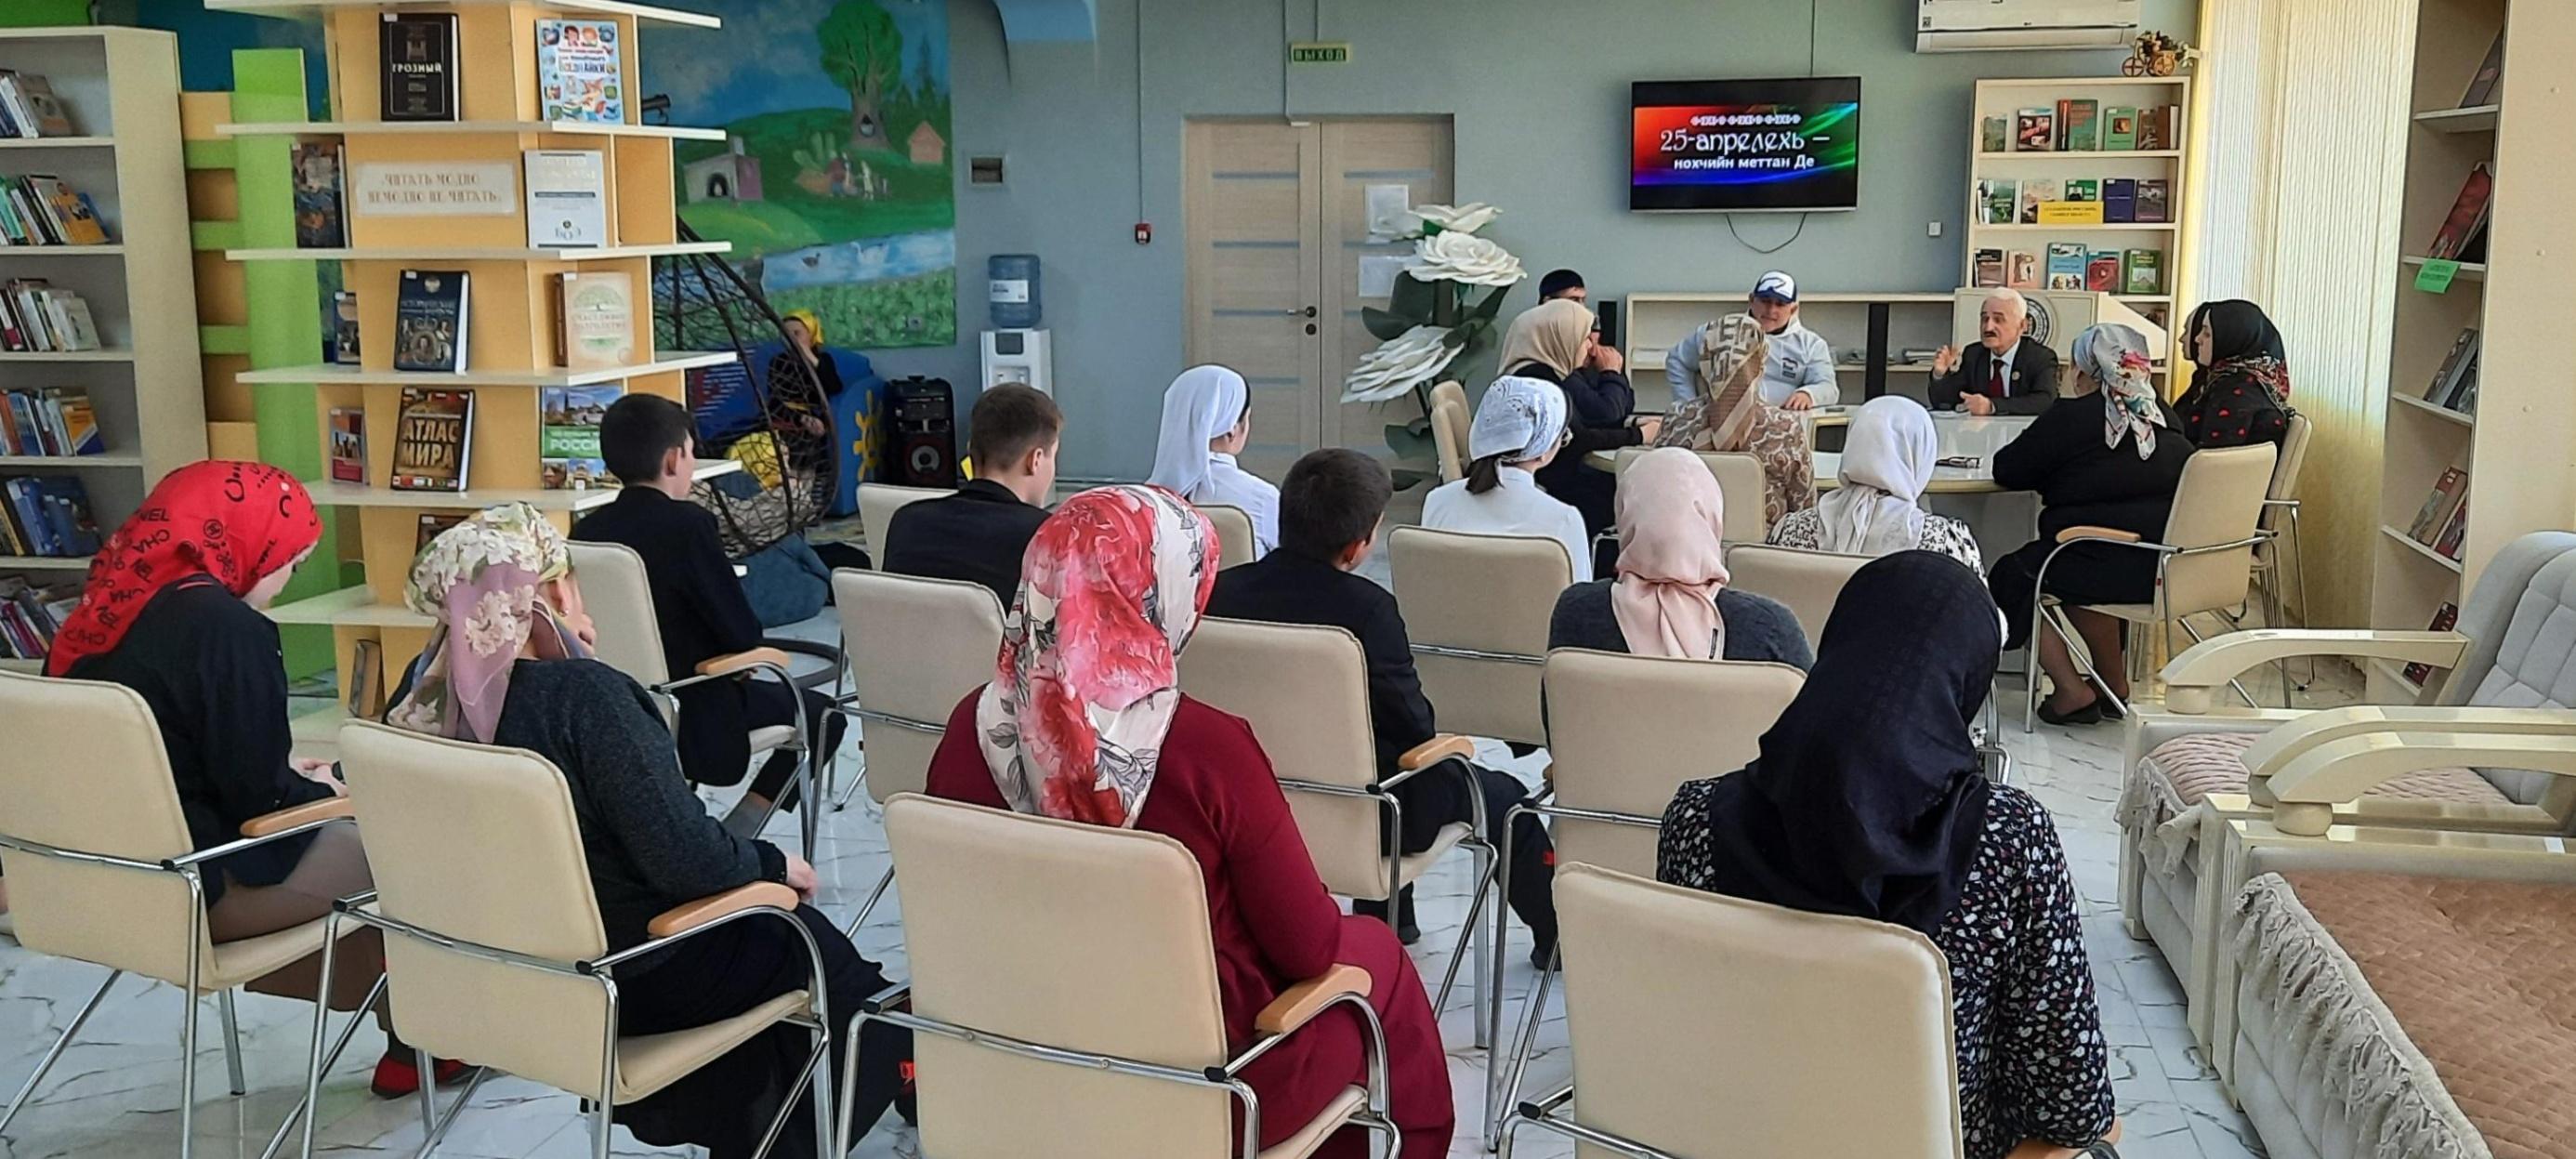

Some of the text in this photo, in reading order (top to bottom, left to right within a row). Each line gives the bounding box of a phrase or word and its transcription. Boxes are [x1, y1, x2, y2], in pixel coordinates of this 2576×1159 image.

[1295, 49, 1345, 61] ВЫХОД
[391, 61, 443, 73] ГРОЗНЫЙ
[1660, 128, 1806, 155] 25-апрелехь
[1674, 154, 1815, 170] нохчийн меттан Де
[401, 418, 461, 443] АТЛАС
[549, 439, 601, 451] РОССИ
[401, 441, 455, 468] МИРА
